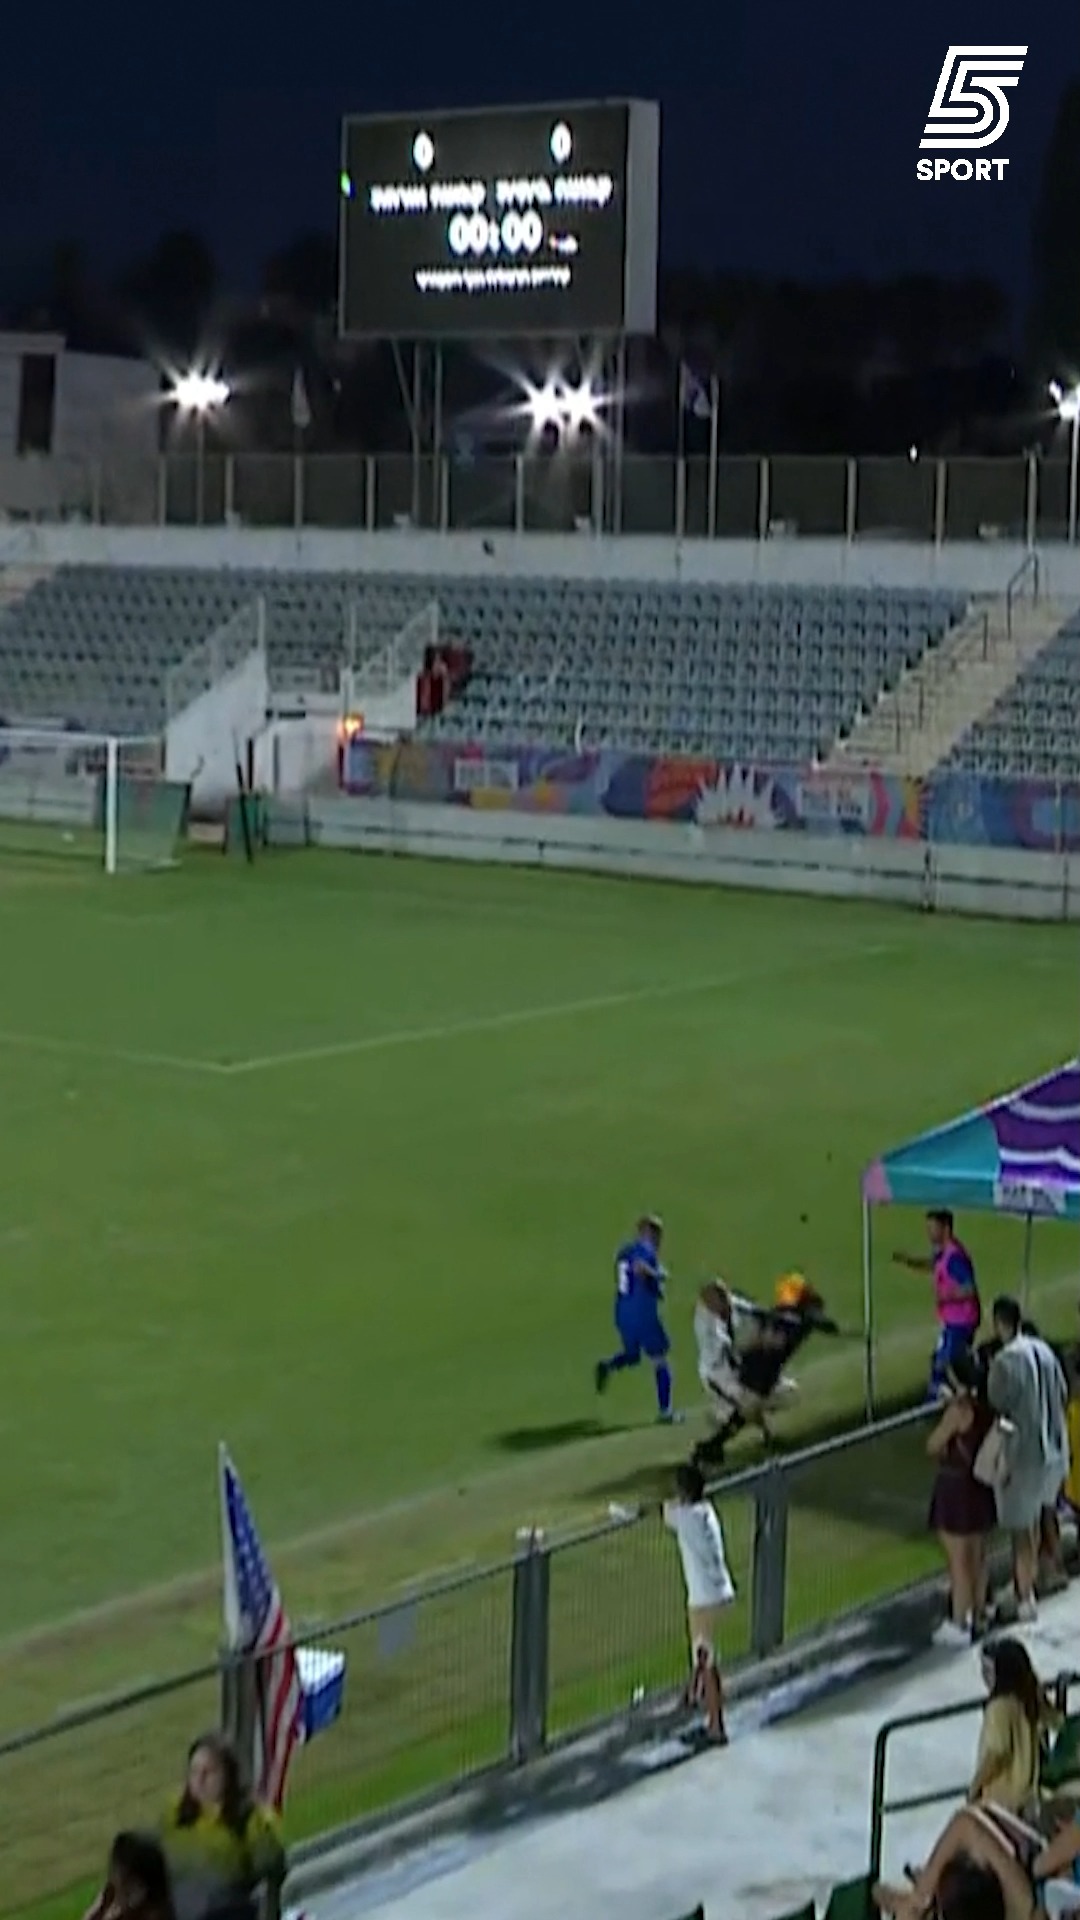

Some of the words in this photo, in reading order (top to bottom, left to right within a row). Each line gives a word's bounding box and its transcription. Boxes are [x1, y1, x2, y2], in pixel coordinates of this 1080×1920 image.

[413, 132, 434, 171] 0
[551, 122, 571, 163] 0
[450, 210, 542, 254] 00:00
